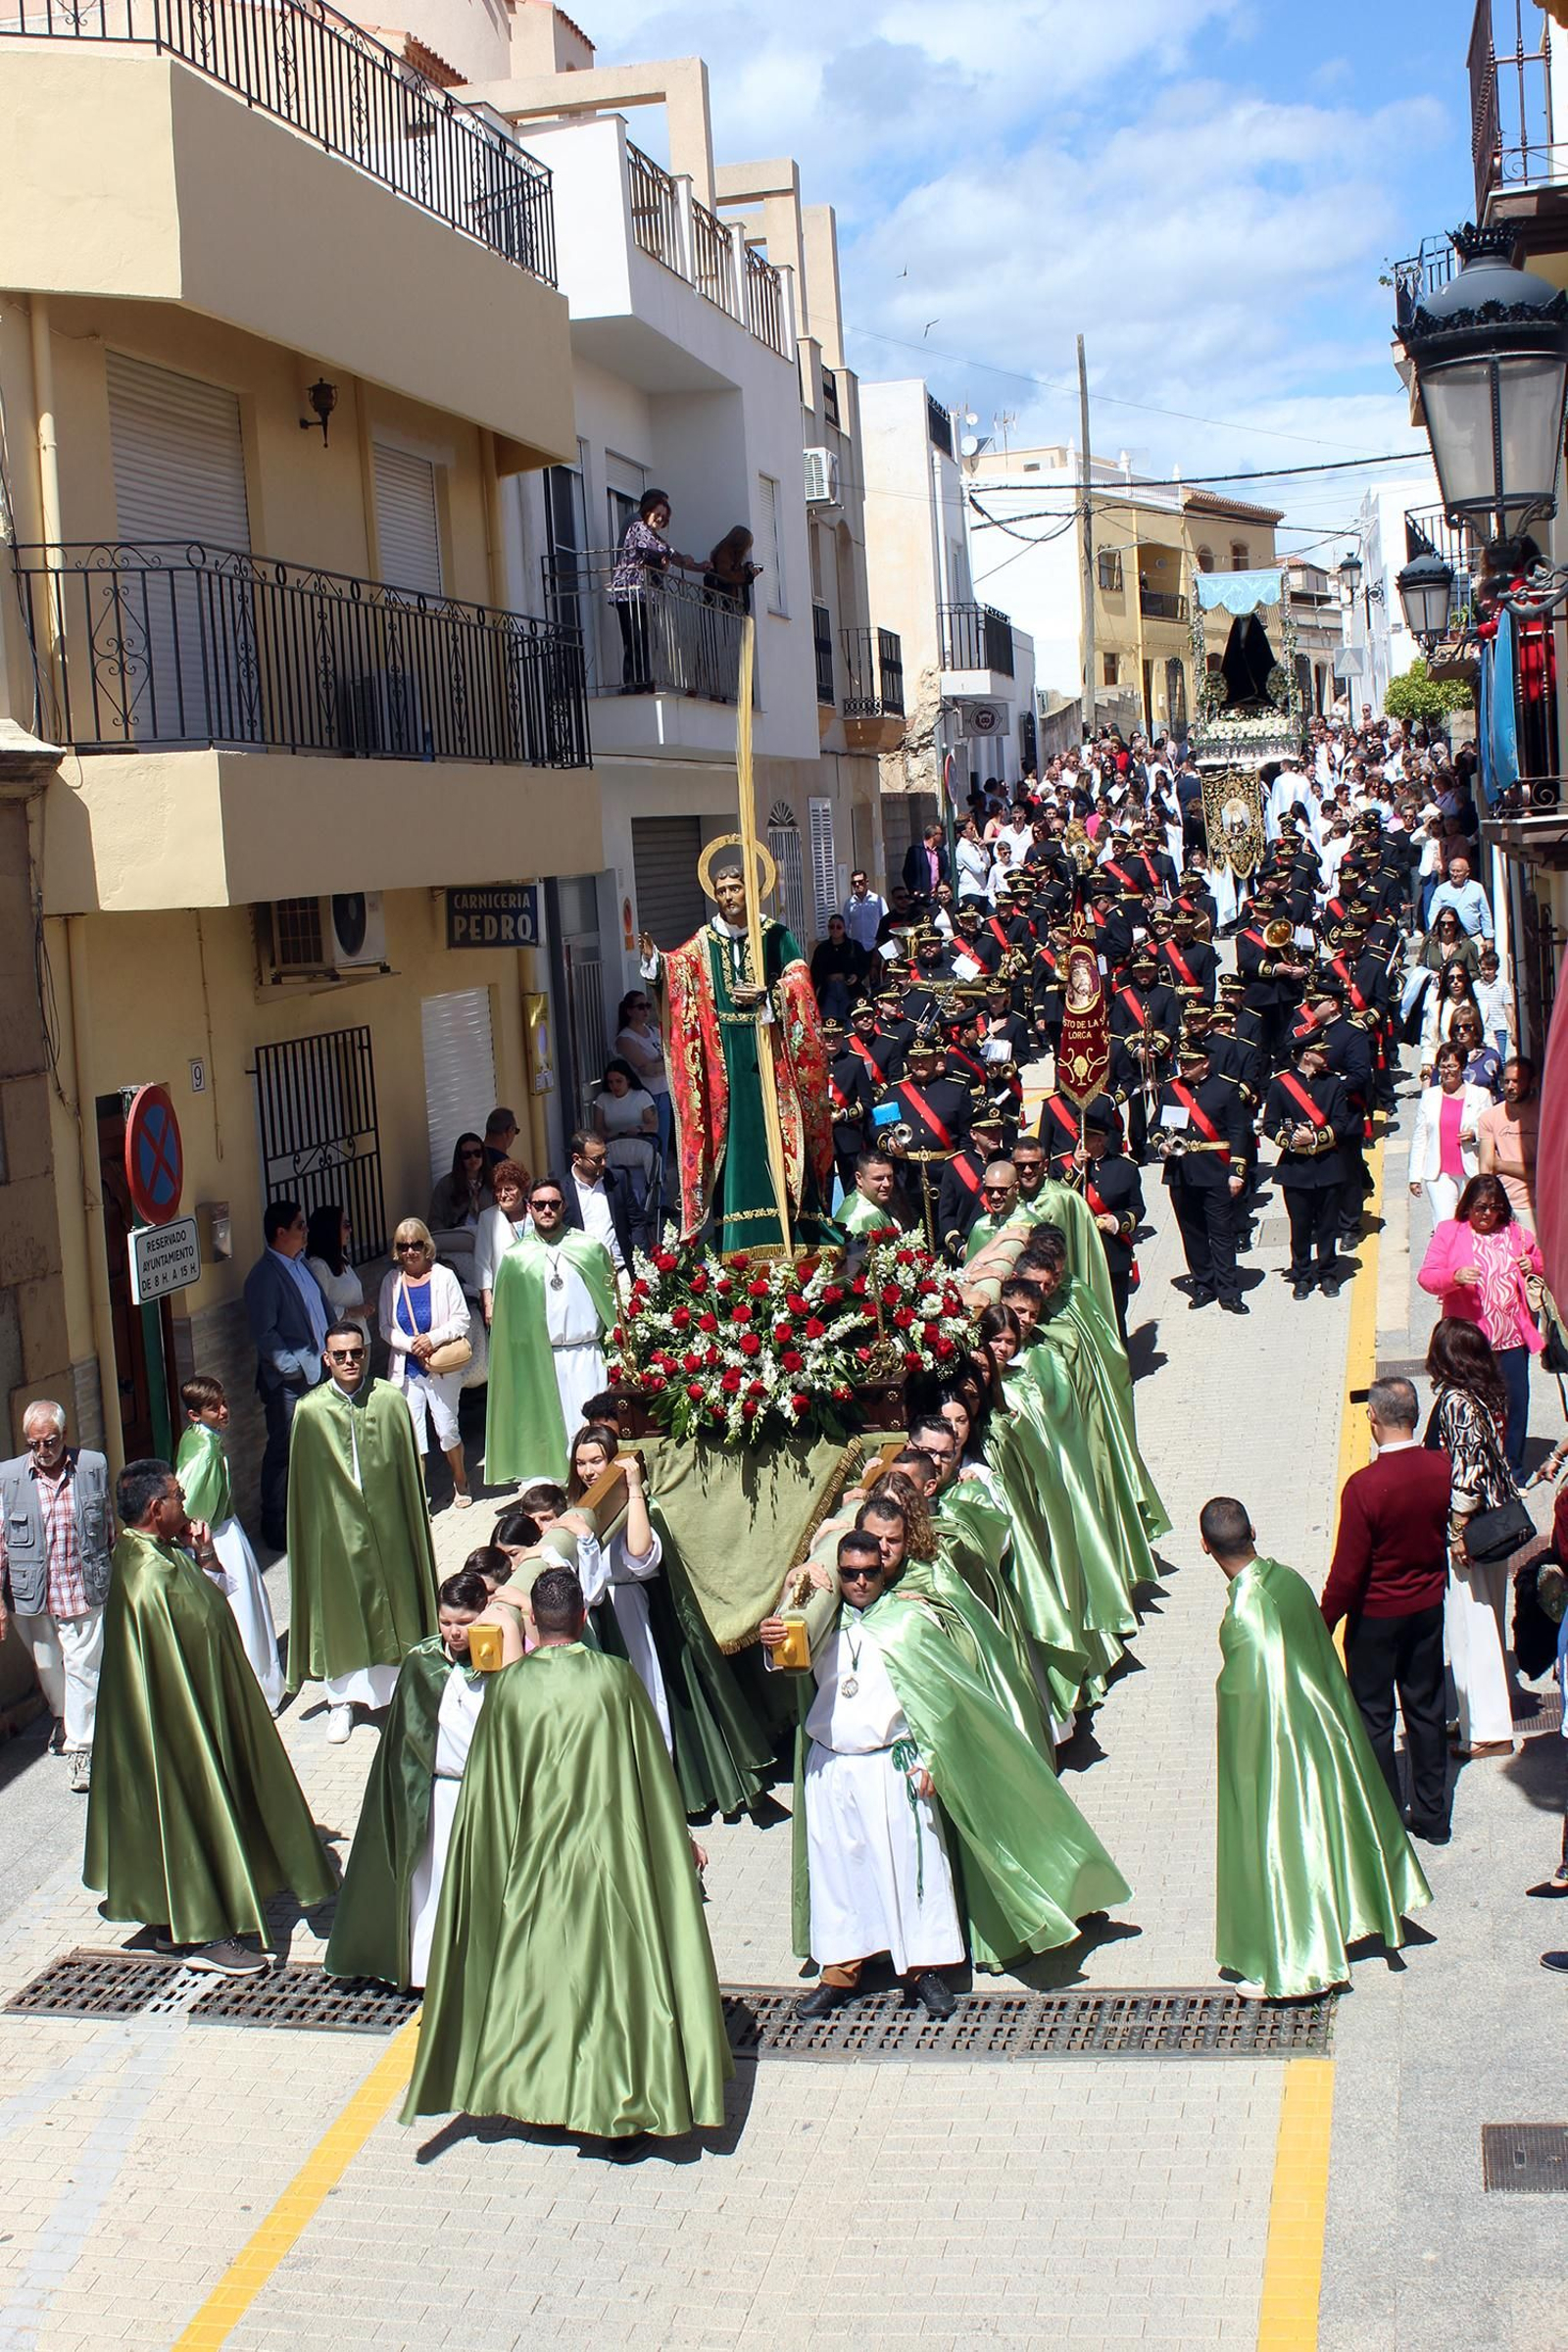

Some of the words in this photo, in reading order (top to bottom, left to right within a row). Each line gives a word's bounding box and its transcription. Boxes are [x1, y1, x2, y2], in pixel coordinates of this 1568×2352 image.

[454, 893, 531, 909] CARNICERIA
[454, 913, 533, 942] PEDRO
[1067, 1031, 1093, 1040] LORCA
[1076, 1020, 1087, 1030] DE
[1087, 1019, 1100, 1029] LA
[194, 1065, 202, 1088] 9
[146, 1230, 187, 1253] RESERVADO
[142, 1246, 194, 1274] AYUNTAMIENTO
[141, 1278, 152, 1292] DE
[154, 1275, 160, 1288] 8
[172, 1269, 178, 1281] A
[180, 1265, 188, 1277] 15
